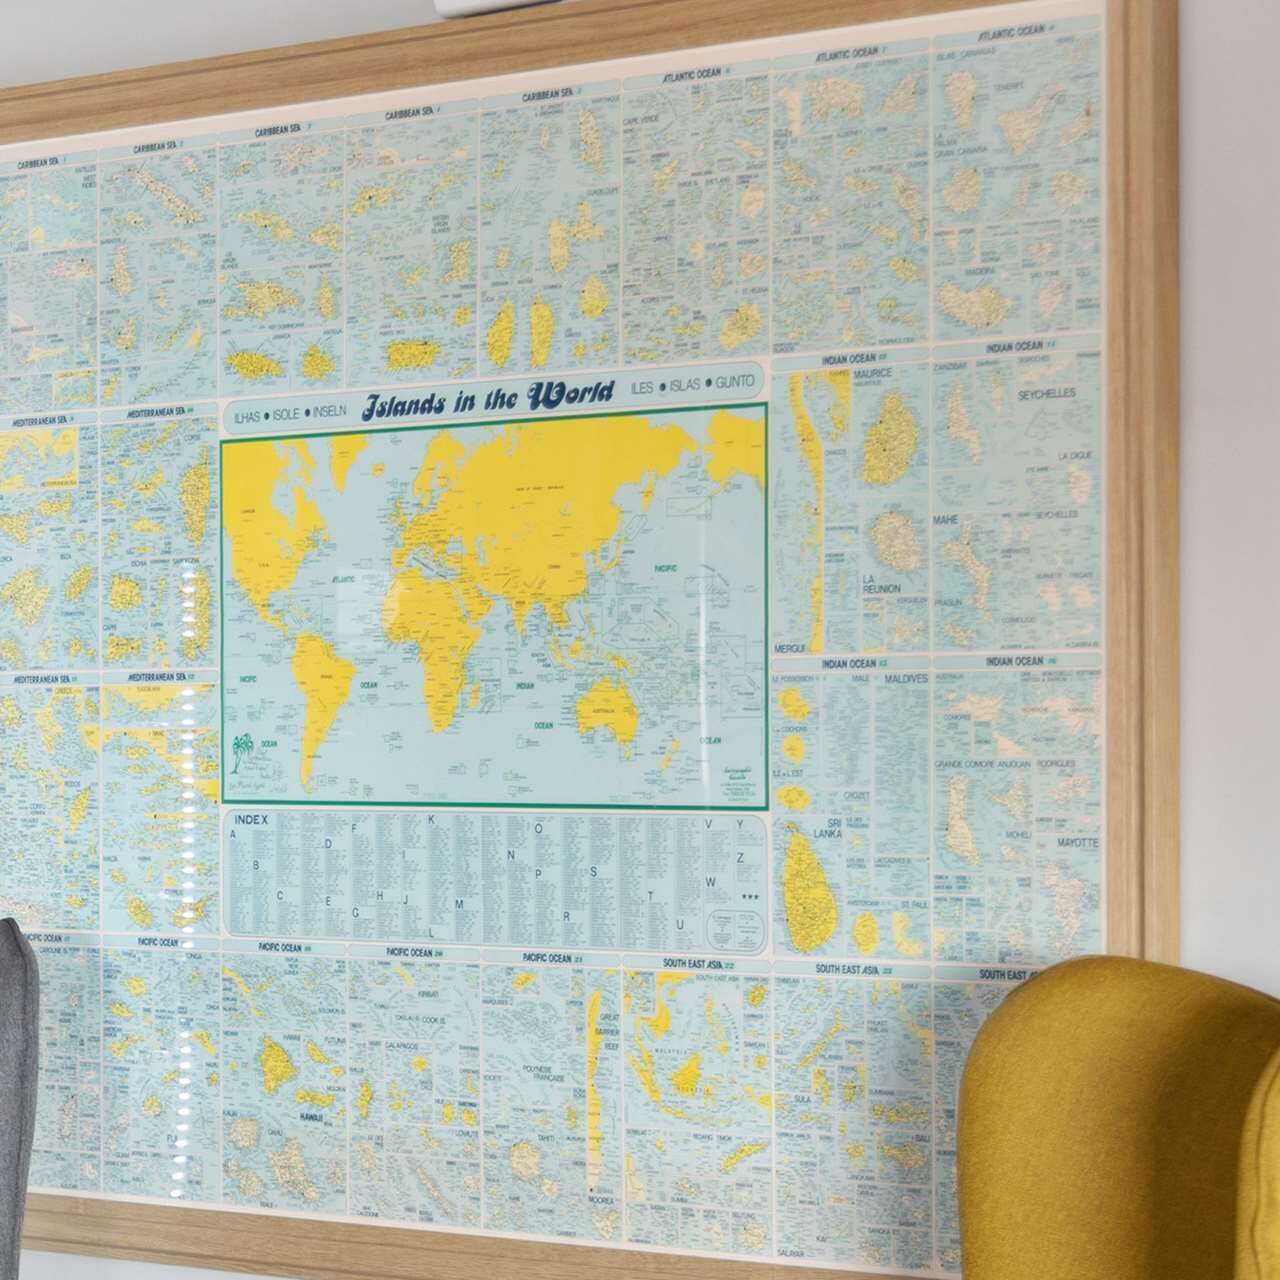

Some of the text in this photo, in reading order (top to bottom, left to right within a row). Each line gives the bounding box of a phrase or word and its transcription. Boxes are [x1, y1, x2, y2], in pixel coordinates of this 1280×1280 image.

[977, 24, 1046, 42] ATLANTIC OCEAN
[816, 47, 878, 62] ATLANTIC OCEAN
[663, 67, 721, 83] ATLANTIC OCEAN
[522, 88, 573, 102] CARIBBEAN SEA
[385, 106, 433, 121] CARIBBEAN SEA
[255, 125, 301, 137] CARIBBEAN SEA
[133, 140, 177, 153] CARIBBEAN SEA
[17, 157, 58, 169] CARIBBEAN SEA
[985, 340, 1043, 353] INDIAN OCEAN
[822, 352, 876, 366] INDIAN OCEAN
[854, 368, 892, 379] MAURICE
[234, 374, 755, 425] ILHAS ISOLE INSELN Islands in the World ILES ISLAS GUNTO
[1018, 387, 1076, 401] SEYCHELLES
[127, 406, 185, 419] MEDITERRANEAN SEA
[12, 415, 67, 427] MEDITERRANEAN SEA
[933, 514, 959, 525] MAHE
[1036, 511, 1078, 519] SEYCHELLES
[863, 575, 874, 584] LA
[863, 584, 901, 594] REUNION
[774, 643, 805, 653] MERGUI
[822, 659, 876, 669] INDIAN OCEAN
[985, 656, 1043, 666] INDIAN OCEAN
[14, 674, 70, 684] MEDITERRANEAN SEA
[128, 672, 186, 682] MEDITERRANEAN SEA
[884, 674, 928, 683] MALDIVES
[935, 760, 994, 768] GRANDE COMORE
[998, 760, 1031, 768] ANJOUAN
[234, 815, 269, 825] INDEX
[828, 818, 841, 828] SRI
[814, 829, 842, 839] LANKA
[1057, 838, 1099, 848] MAYOTTE
[43, 933, 62, 943] OCEAN
[138, 937, 178, 947] PACIFIC OCEAN
[258, 942, 302, 953] PACIFIC OCEAN
[386, 947, 432, 958] PACIFIC OCEAN
[523, 952, 571, 963] PACIFIC OCEAN
[663, 957, 723, 969] SOUTH EAST ASIA
[816, 963, 879, 975] SOUTH EAST ASIA
[979, 969, 1004, 980] SOUTH
[1006, 970, 1027, 981] EAST
[300, 1112, 324, 1122] HAWAII
